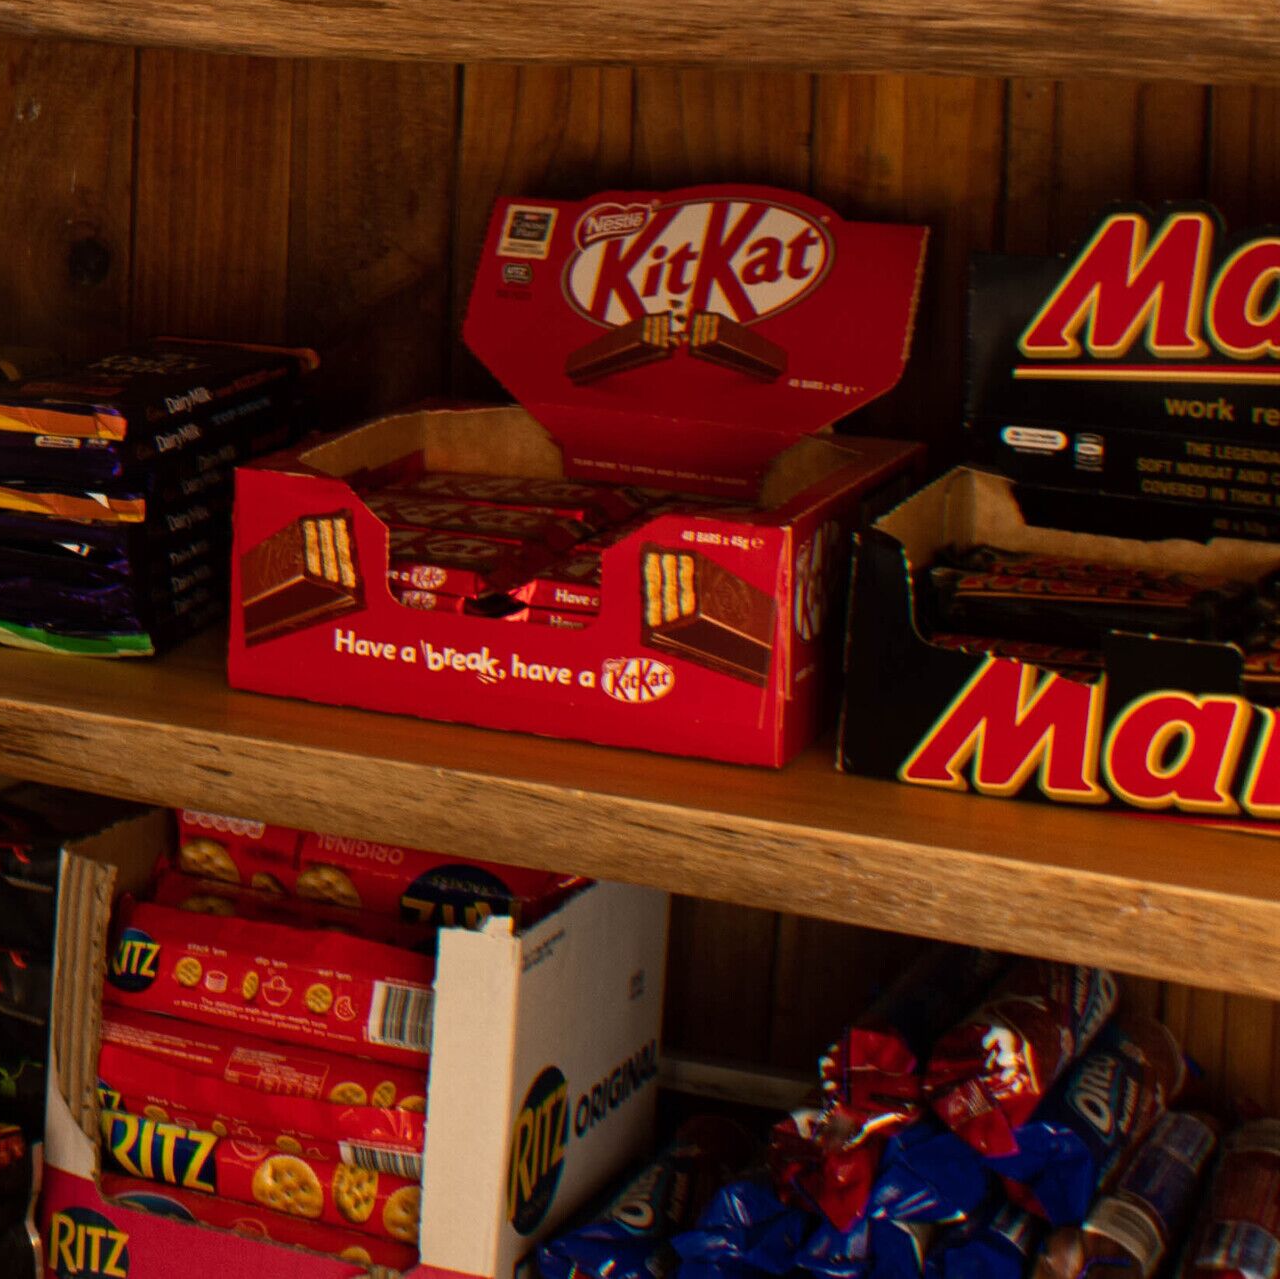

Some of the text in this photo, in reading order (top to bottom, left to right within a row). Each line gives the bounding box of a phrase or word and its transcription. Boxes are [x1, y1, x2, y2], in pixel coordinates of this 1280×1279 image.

[1165, 397, 1235, 422] work
[334, 628, 416, 662] Have a
[511, 653, 573, 685] have
[579, 669, 595, 687] a
[508, 1039, 660, 1223] RITZ ORIGINAL
[49, 1212, 132, 1279] RITZ
